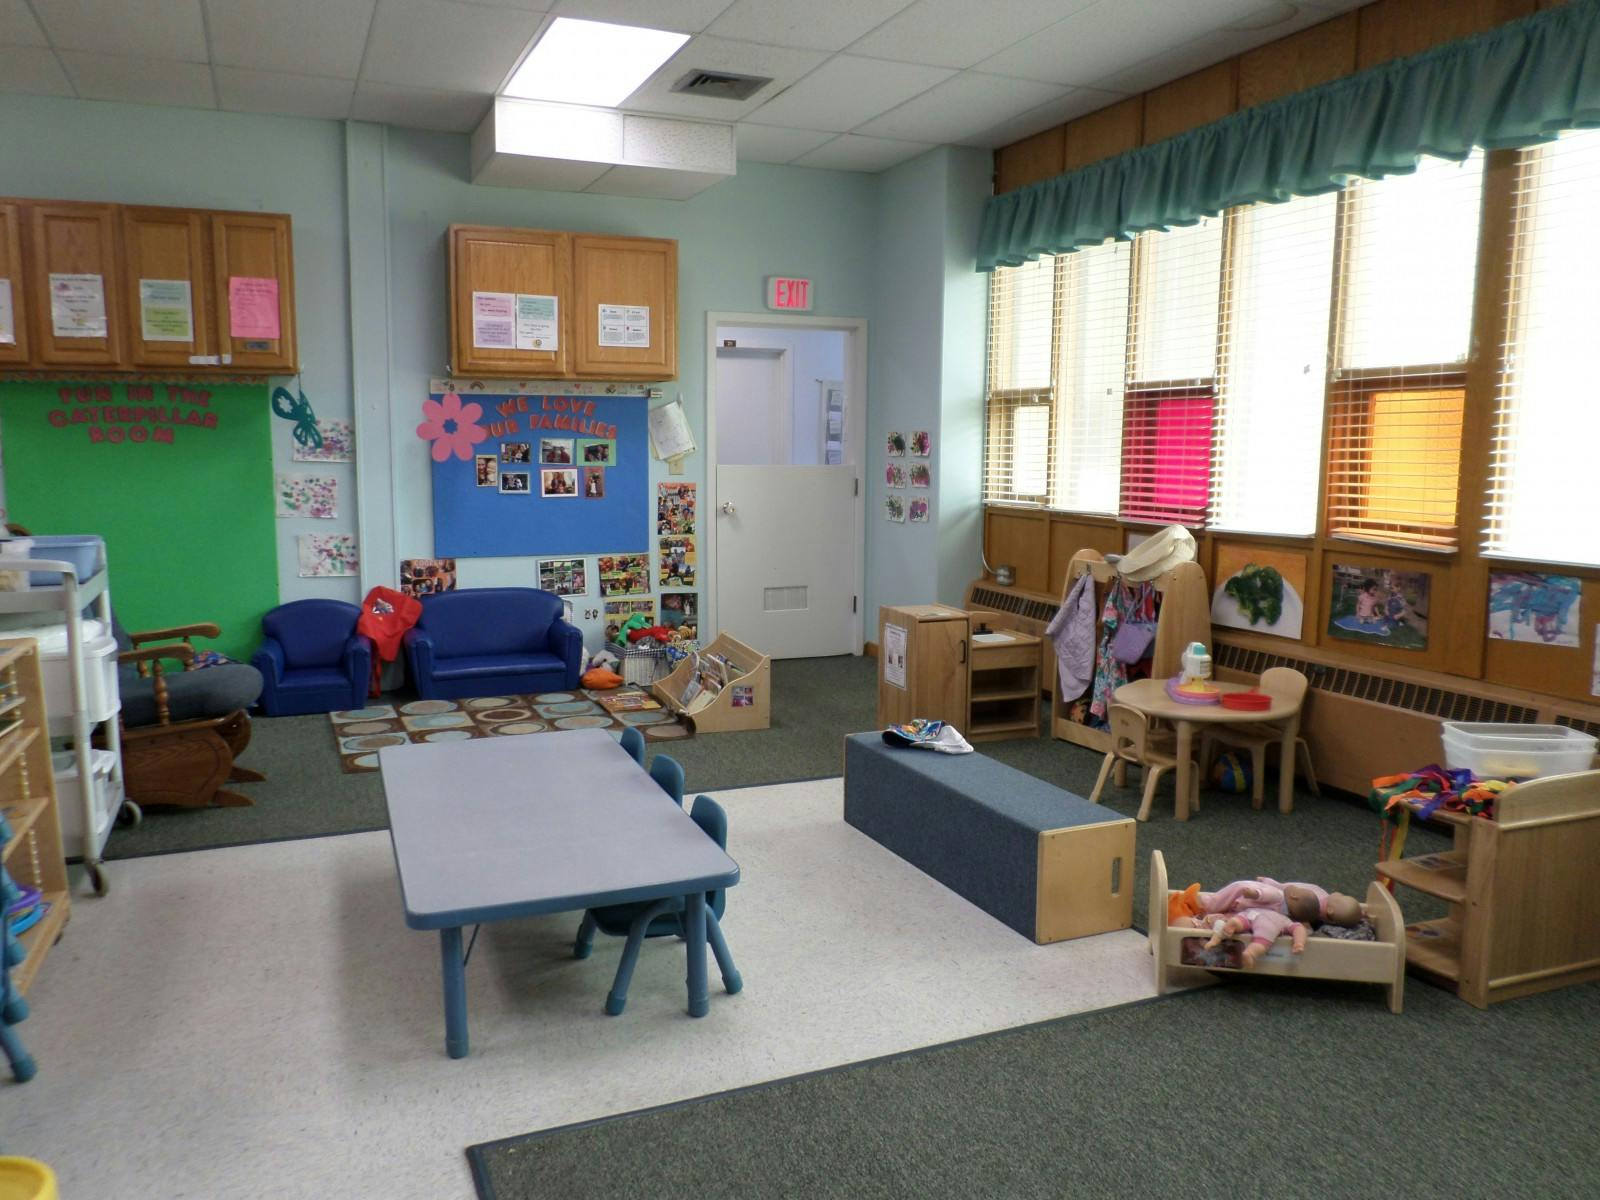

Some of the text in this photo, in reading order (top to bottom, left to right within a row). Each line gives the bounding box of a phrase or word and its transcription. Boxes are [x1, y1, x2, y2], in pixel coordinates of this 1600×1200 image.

[776, 279, 808, 308] EXIT
[59, 384, 214, 408] FUN IN THE
[496, 395, 597, 417] WE LOVE
[50, 406, 218, 430] CATERPILLAR
[529, 414, 617, 439] FAMILIES
[89, 425, 175, 444] ROOM
